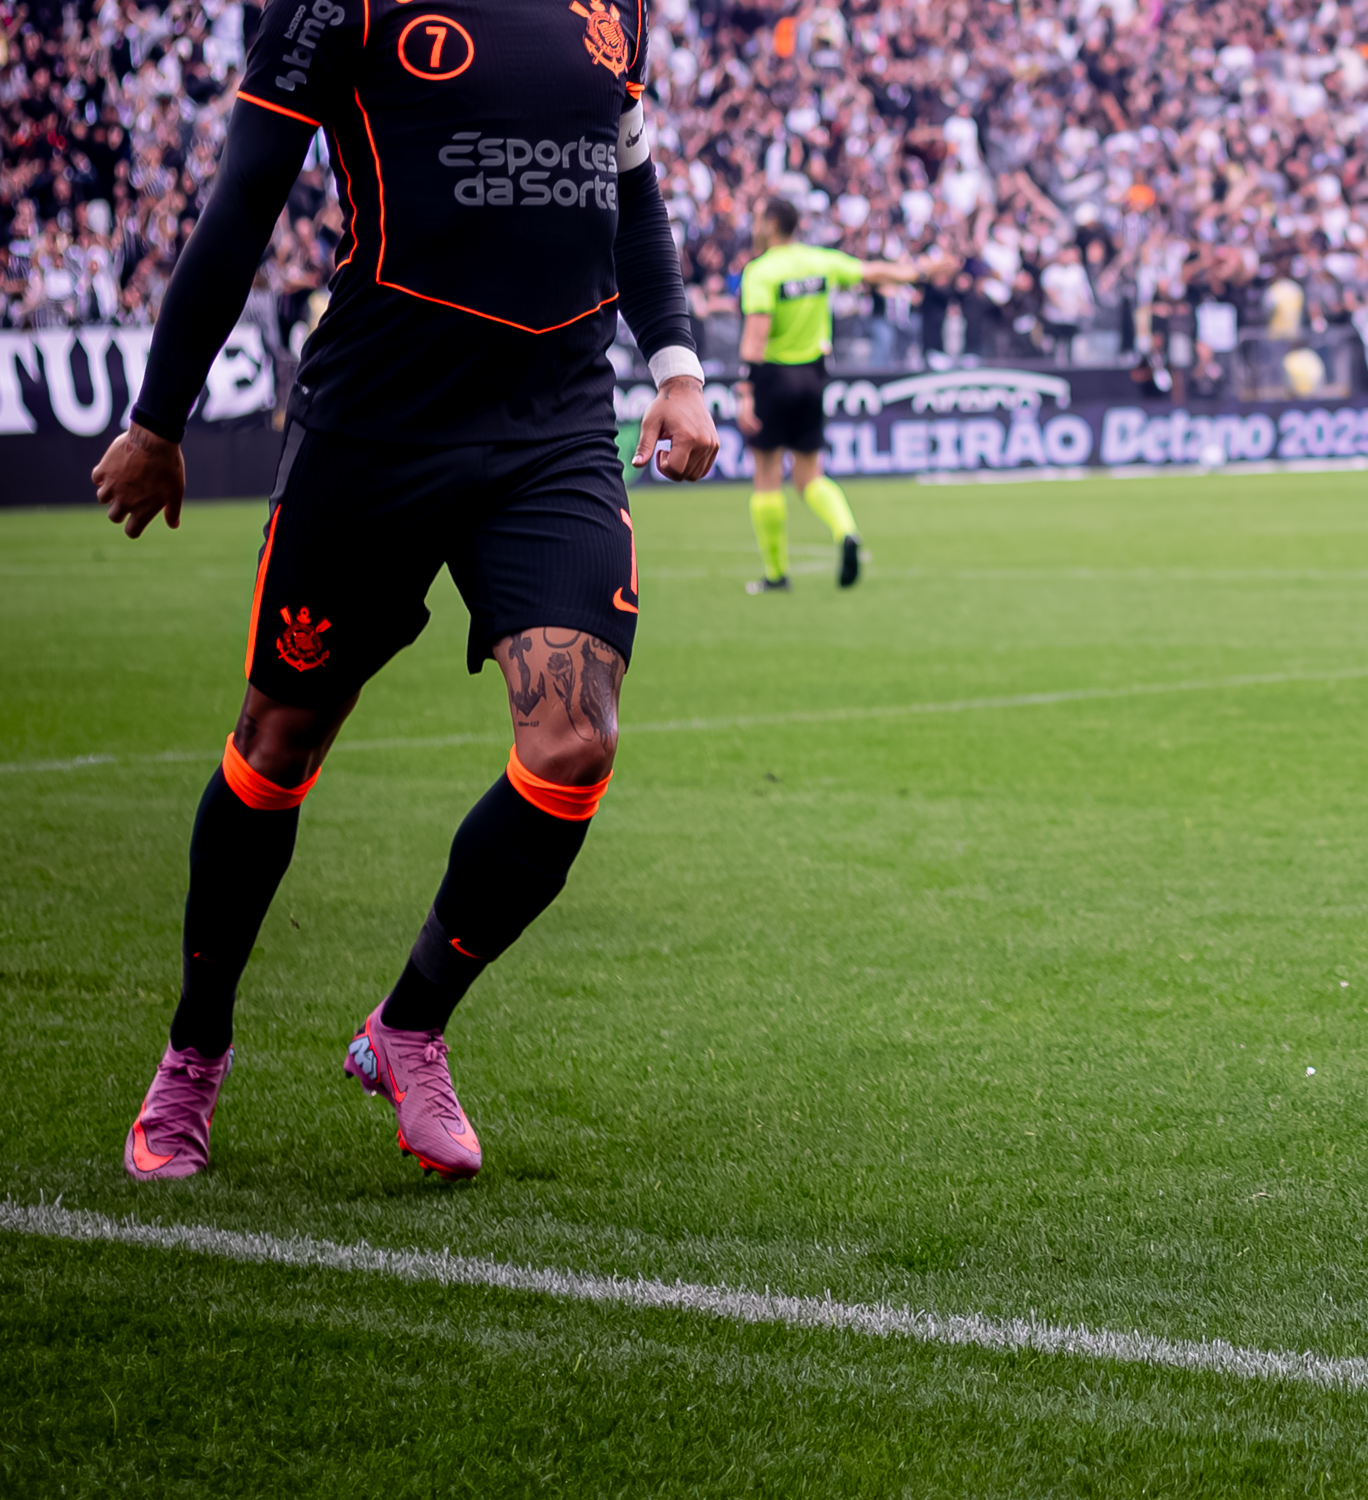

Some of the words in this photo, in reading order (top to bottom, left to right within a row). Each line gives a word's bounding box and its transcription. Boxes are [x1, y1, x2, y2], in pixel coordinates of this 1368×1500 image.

[284, 4, 307, 40] banco
[425, 26, 447, 68] 7
[438, 131, 618, 176] Esportes
